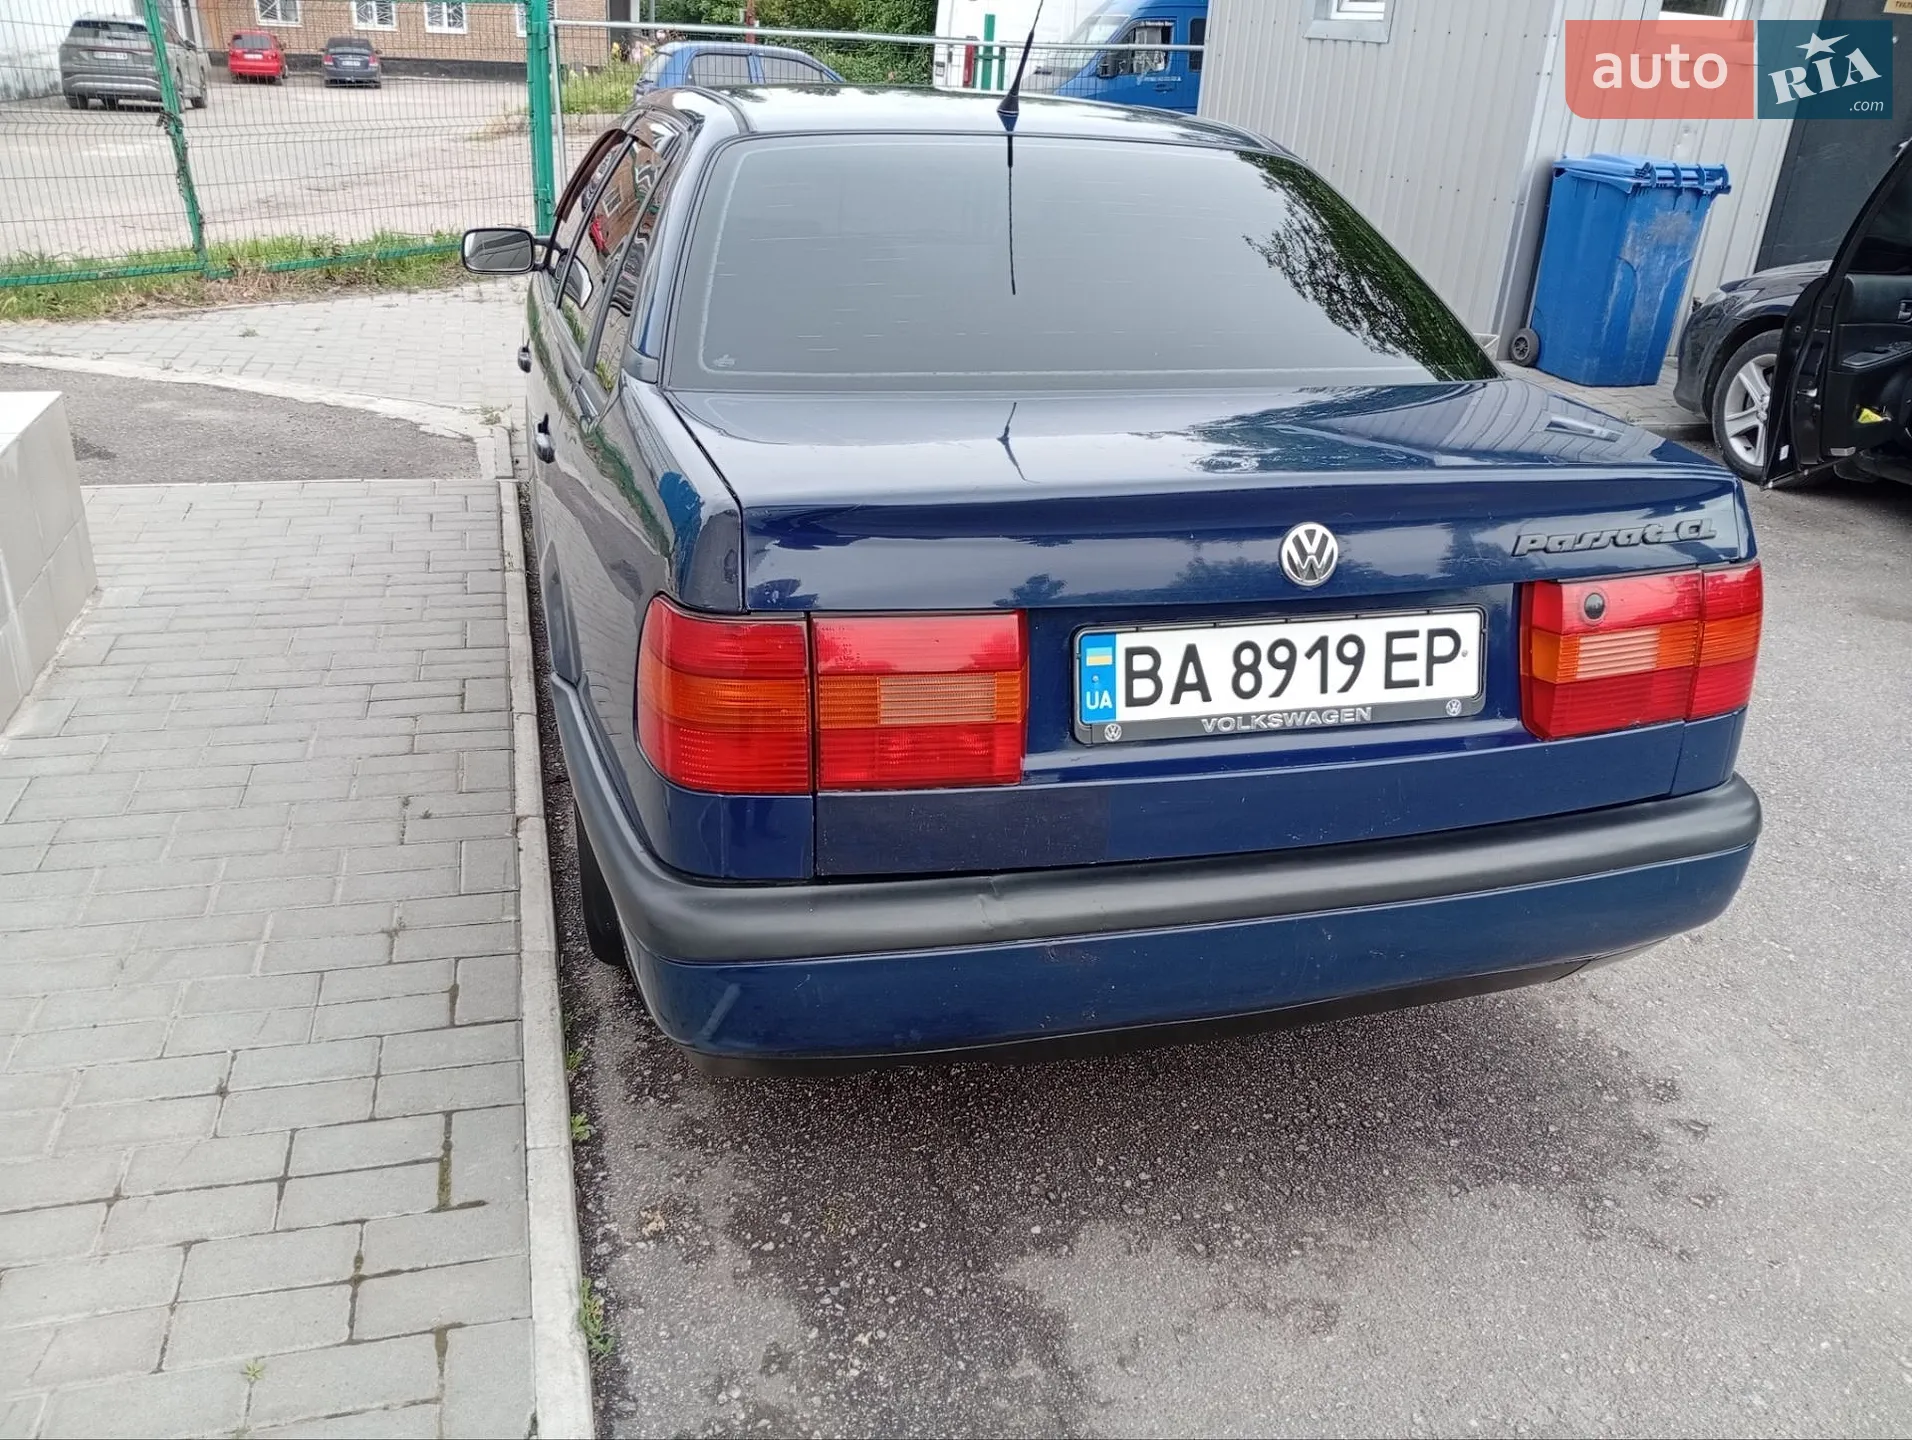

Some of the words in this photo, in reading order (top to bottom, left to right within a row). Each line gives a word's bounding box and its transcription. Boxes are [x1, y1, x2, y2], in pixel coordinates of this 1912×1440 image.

[1511, 523, 1664, 557] Passat
[1677, 518, 1717, 541] CL
[1124, 643, 1212, 707] BA
[1230, 634, 1365, 700] 8919
[1384, 627, 1462, 690] EP
[1086, 690, 1112, 710] UA
[1201, 706, 1372, 733] VOLKSWAGEN
